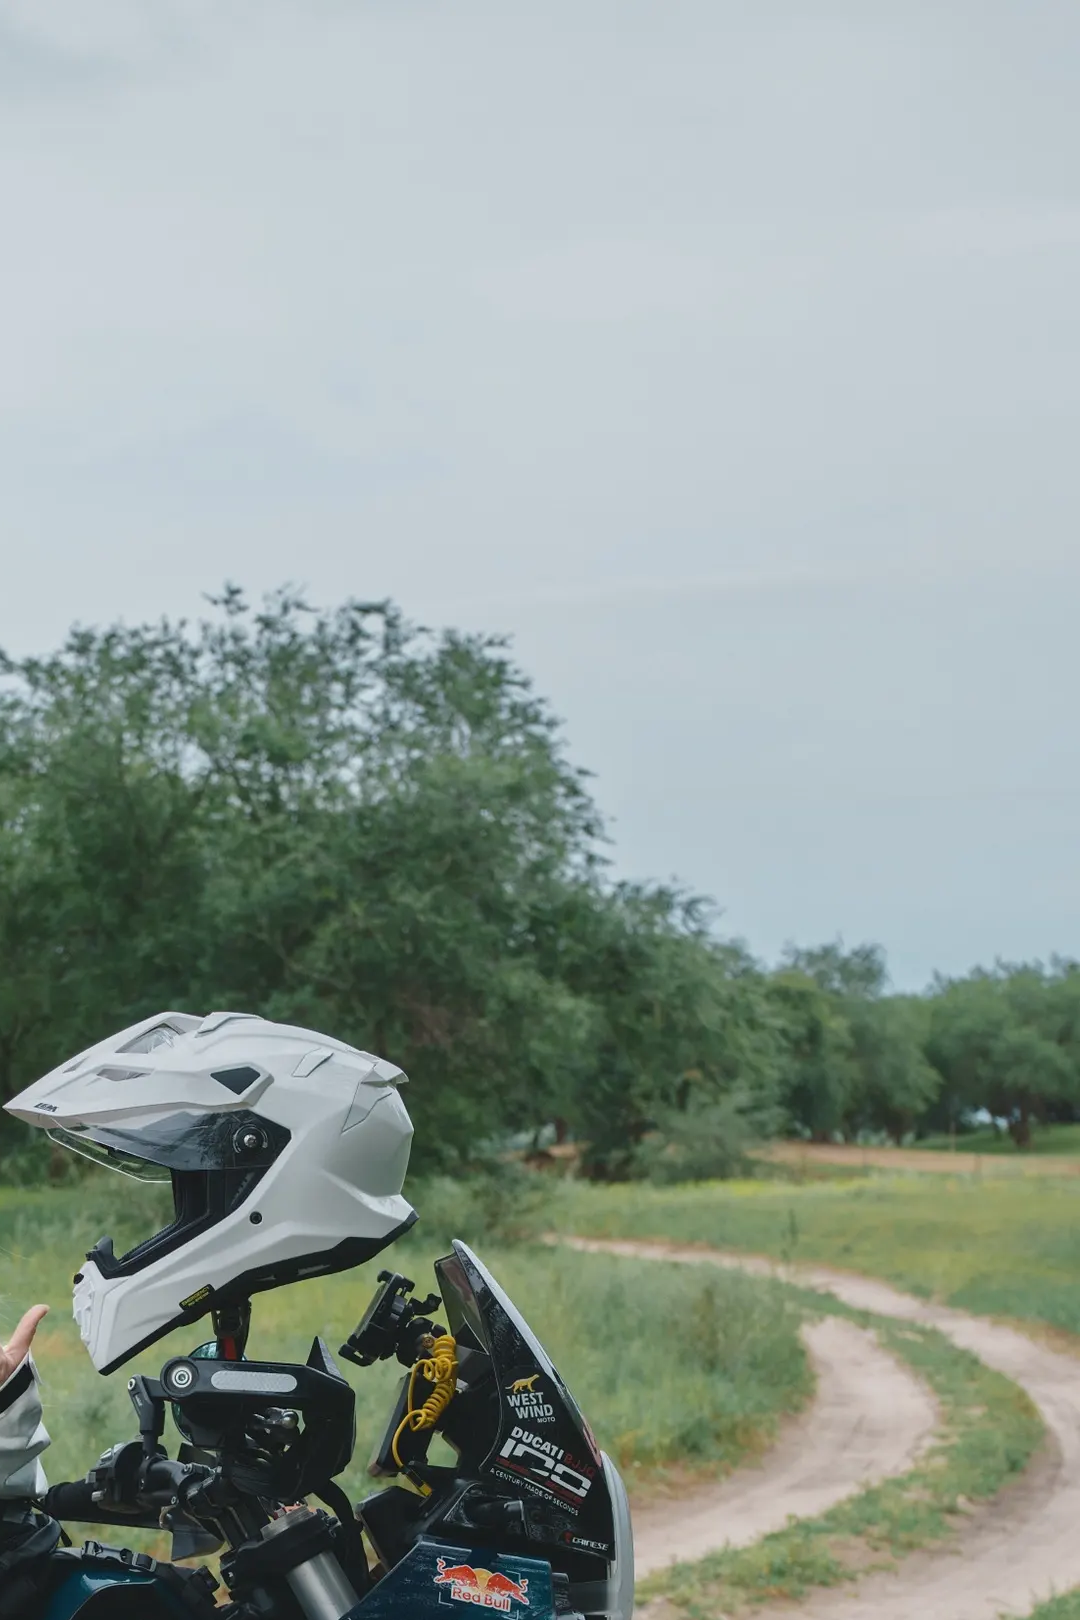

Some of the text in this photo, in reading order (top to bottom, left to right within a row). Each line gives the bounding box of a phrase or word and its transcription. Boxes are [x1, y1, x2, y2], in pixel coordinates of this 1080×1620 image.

[507, 1392, 544, 1407] WEST
[515, 1404, 553, 1419] WIND
[511, 1426, 564, 1459] DUCATI
[496, 1470, 524, 1487] CENTURY
[524, 1483, 543, 1497] MADE
[544, 1492, 553, 1501] OF
[553, 1498, 579, 1516] SECONDS
[452, 1587, 511, 1612] Red Bull
